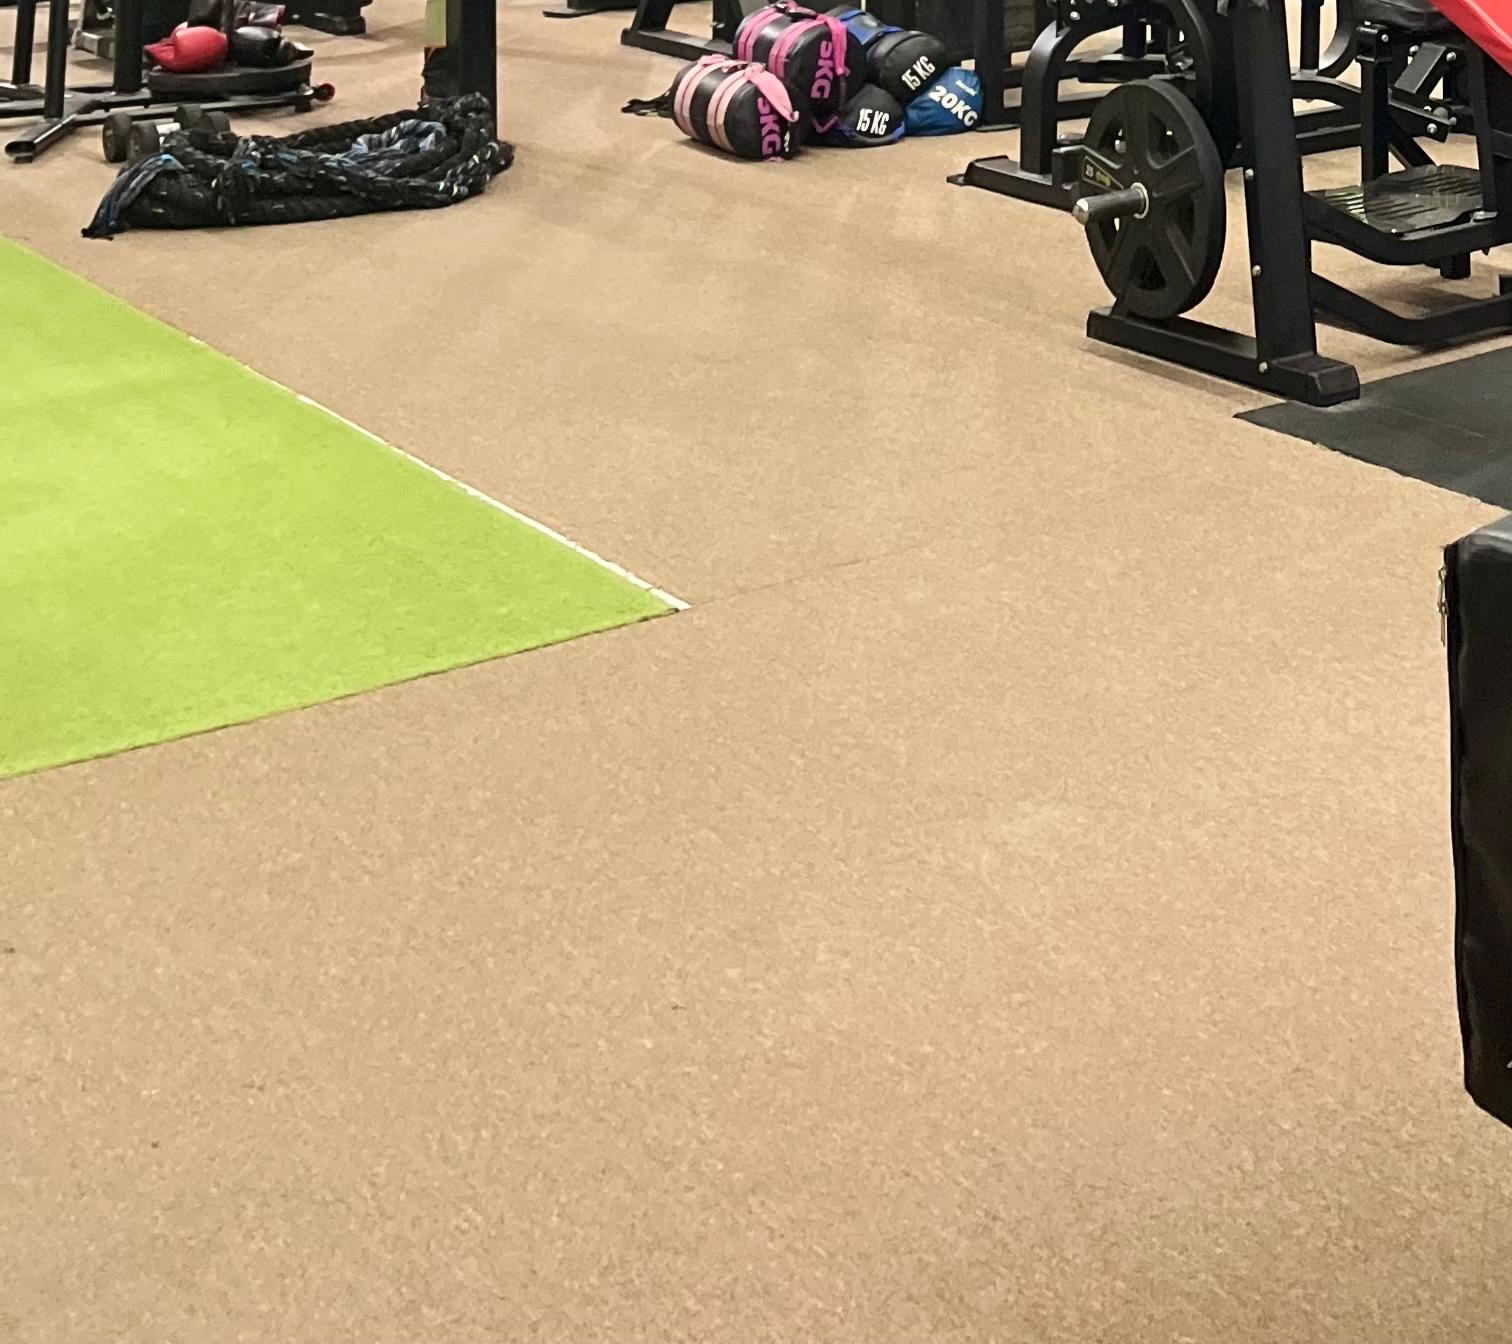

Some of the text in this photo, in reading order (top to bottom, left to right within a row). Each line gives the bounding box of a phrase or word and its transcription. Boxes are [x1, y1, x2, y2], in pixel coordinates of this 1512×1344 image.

[901, 55, 936, 91] 15 KG
[856, 108, 890, 136] 15 KG
